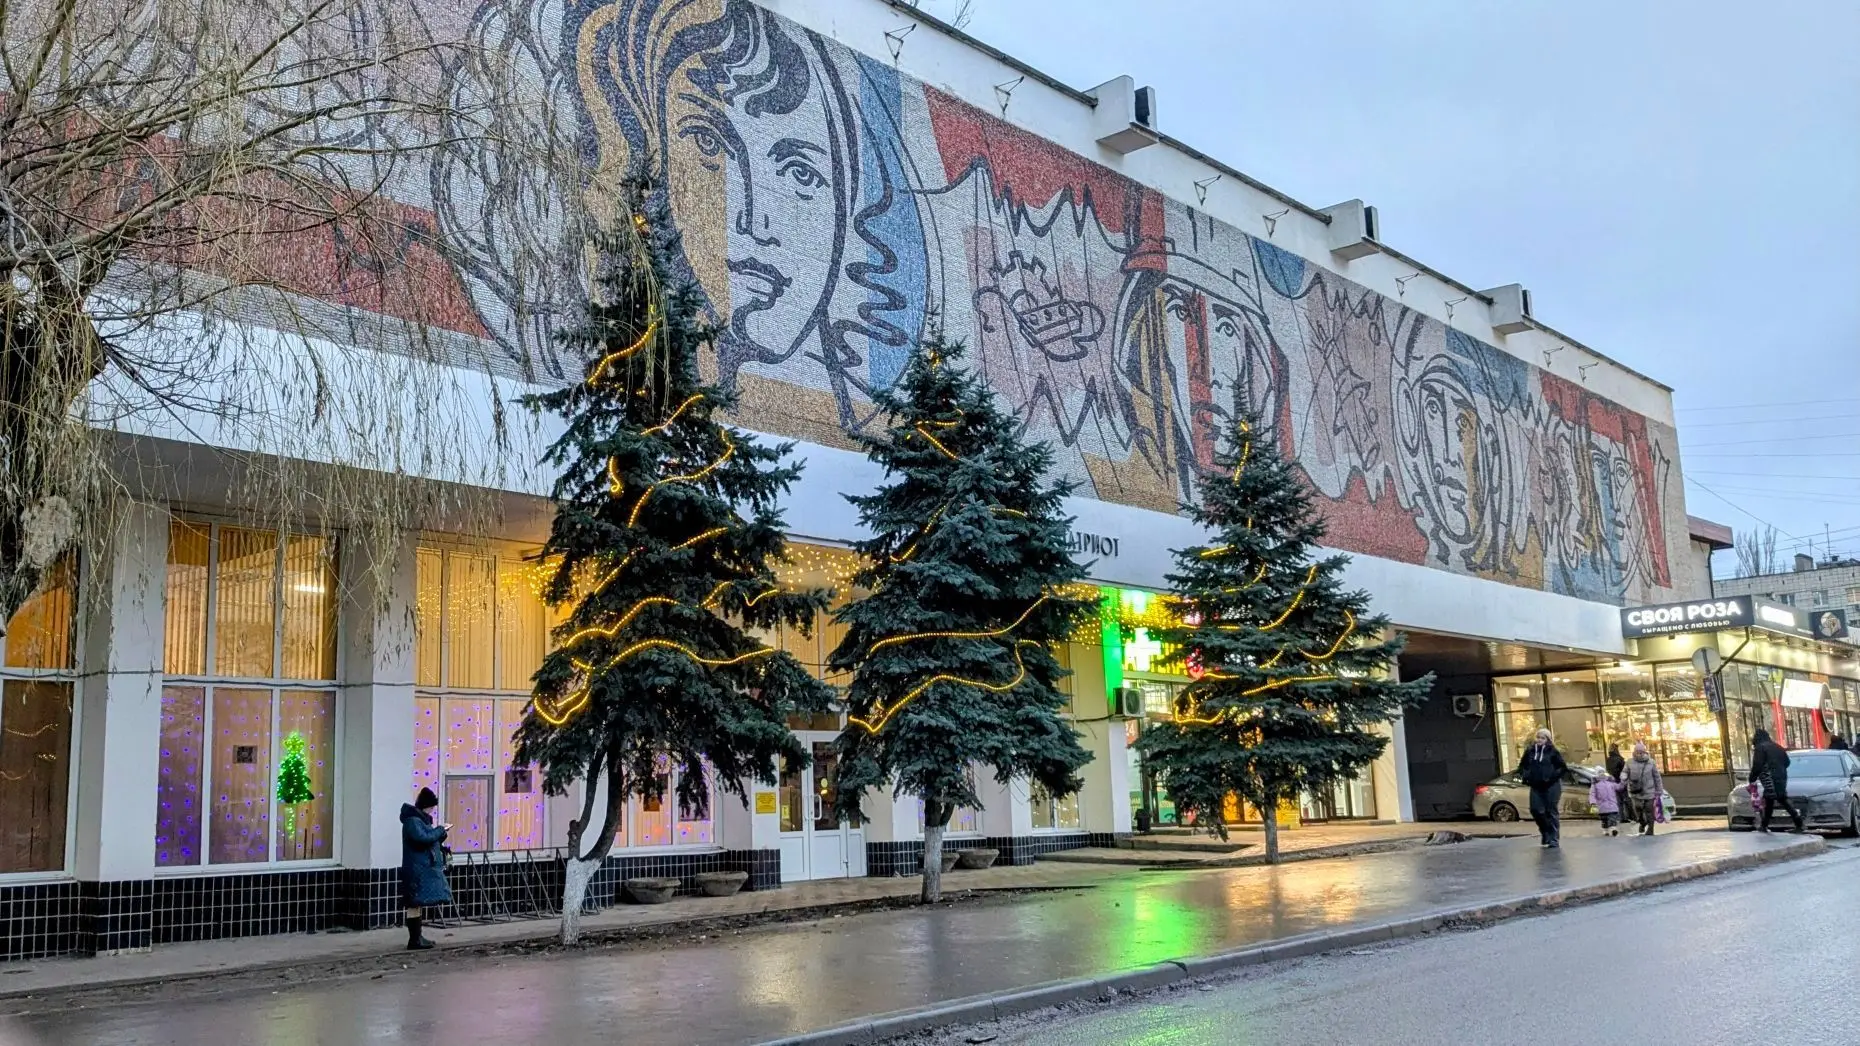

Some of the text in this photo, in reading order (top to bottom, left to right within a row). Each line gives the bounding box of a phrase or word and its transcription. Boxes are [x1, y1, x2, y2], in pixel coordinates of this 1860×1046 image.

[1064, 530, 1120, 557] АТРИОТ
[1627, 606, 1683, 626] СВОЯ
[1687, 600, 1742, 620] РОЗА
